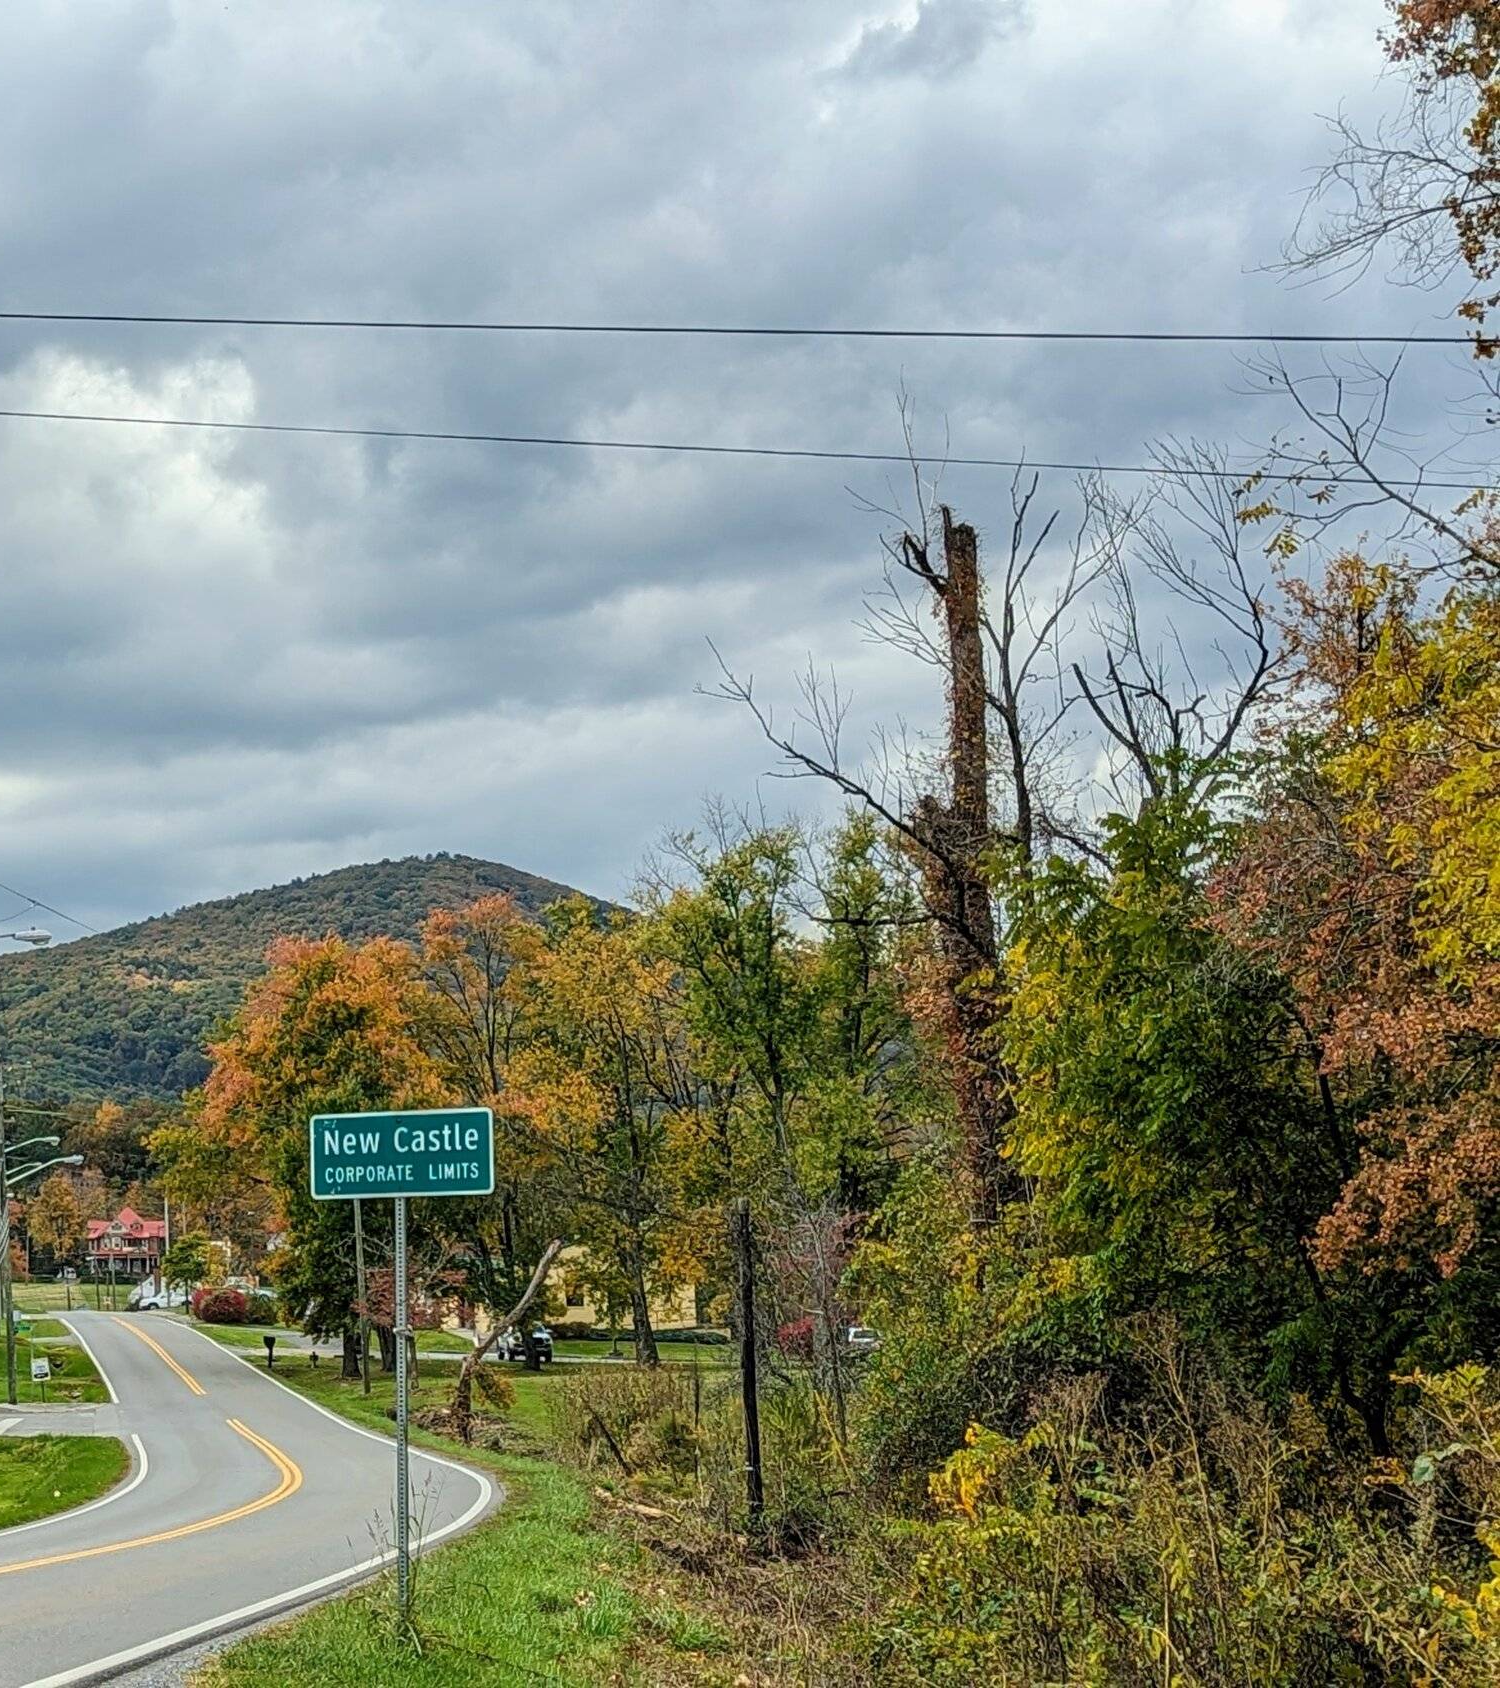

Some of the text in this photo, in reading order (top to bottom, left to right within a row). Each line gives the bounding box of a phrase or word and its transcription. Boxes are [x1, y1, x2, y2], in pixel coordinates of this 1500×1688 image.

[324, 1123, 479, 1155] New Castle
[325, 1162, 479, 1183] CORPORATE LIMITS
